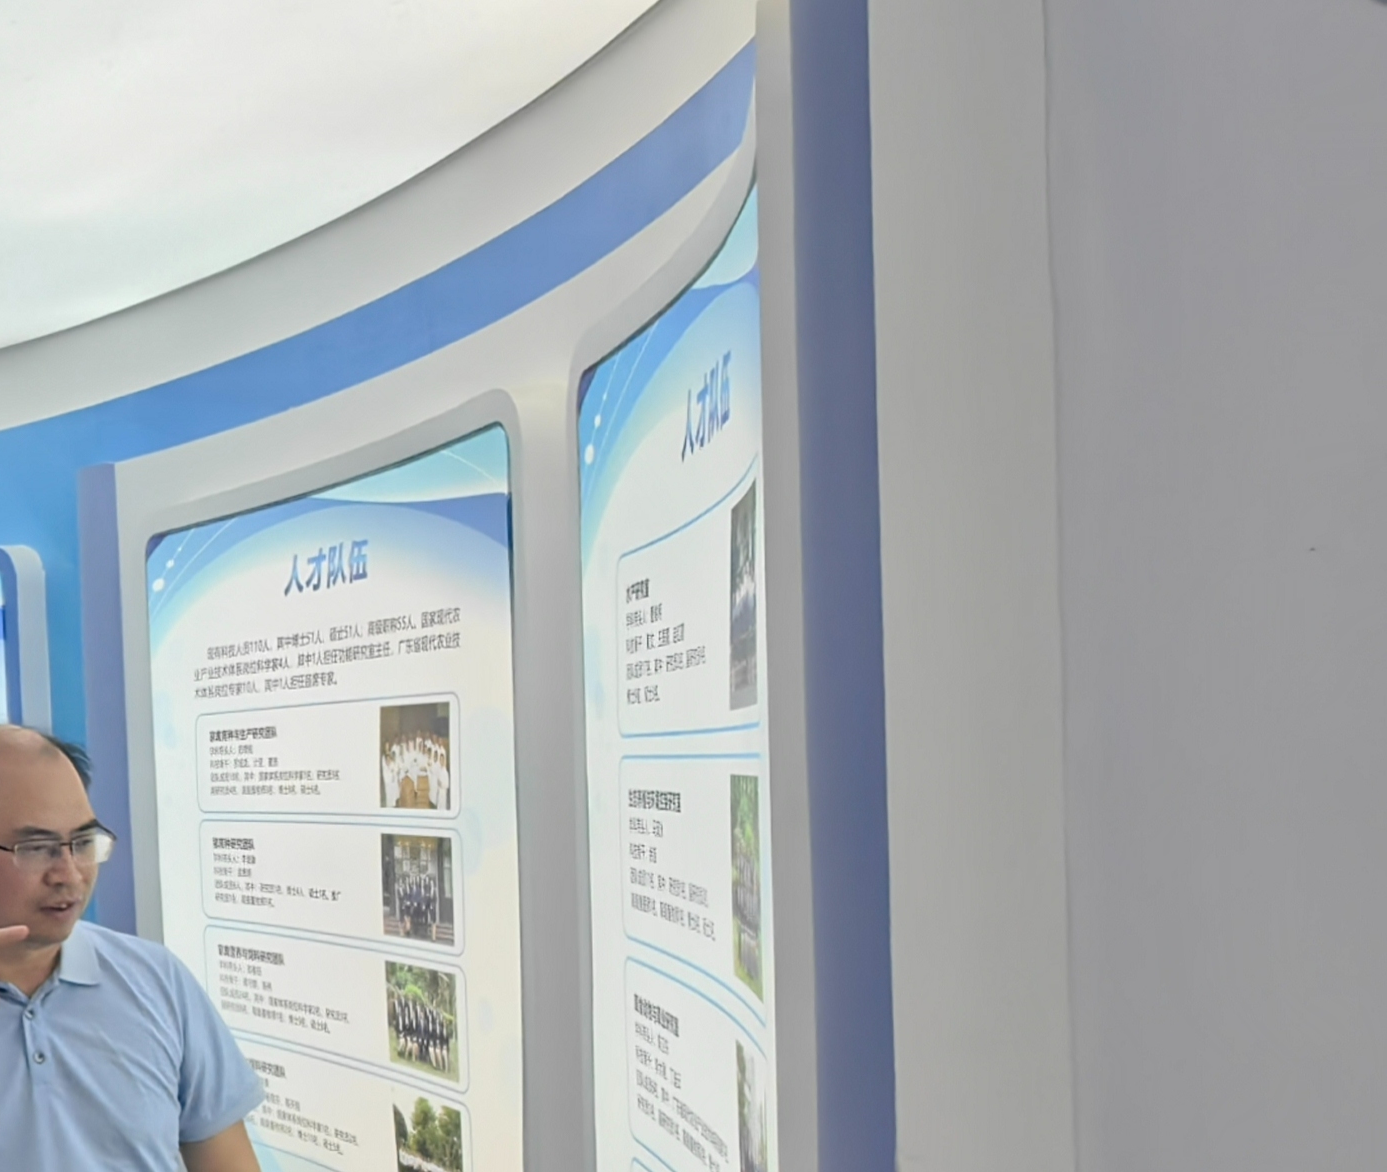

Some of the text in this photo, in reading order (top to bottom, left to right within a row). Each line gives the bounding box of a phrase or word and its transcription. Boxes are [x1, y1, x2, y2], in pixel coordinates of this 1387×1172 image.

[681, 350, 732, 462] 人才队伍
[284, 539, 369, 596] 人才队伍
